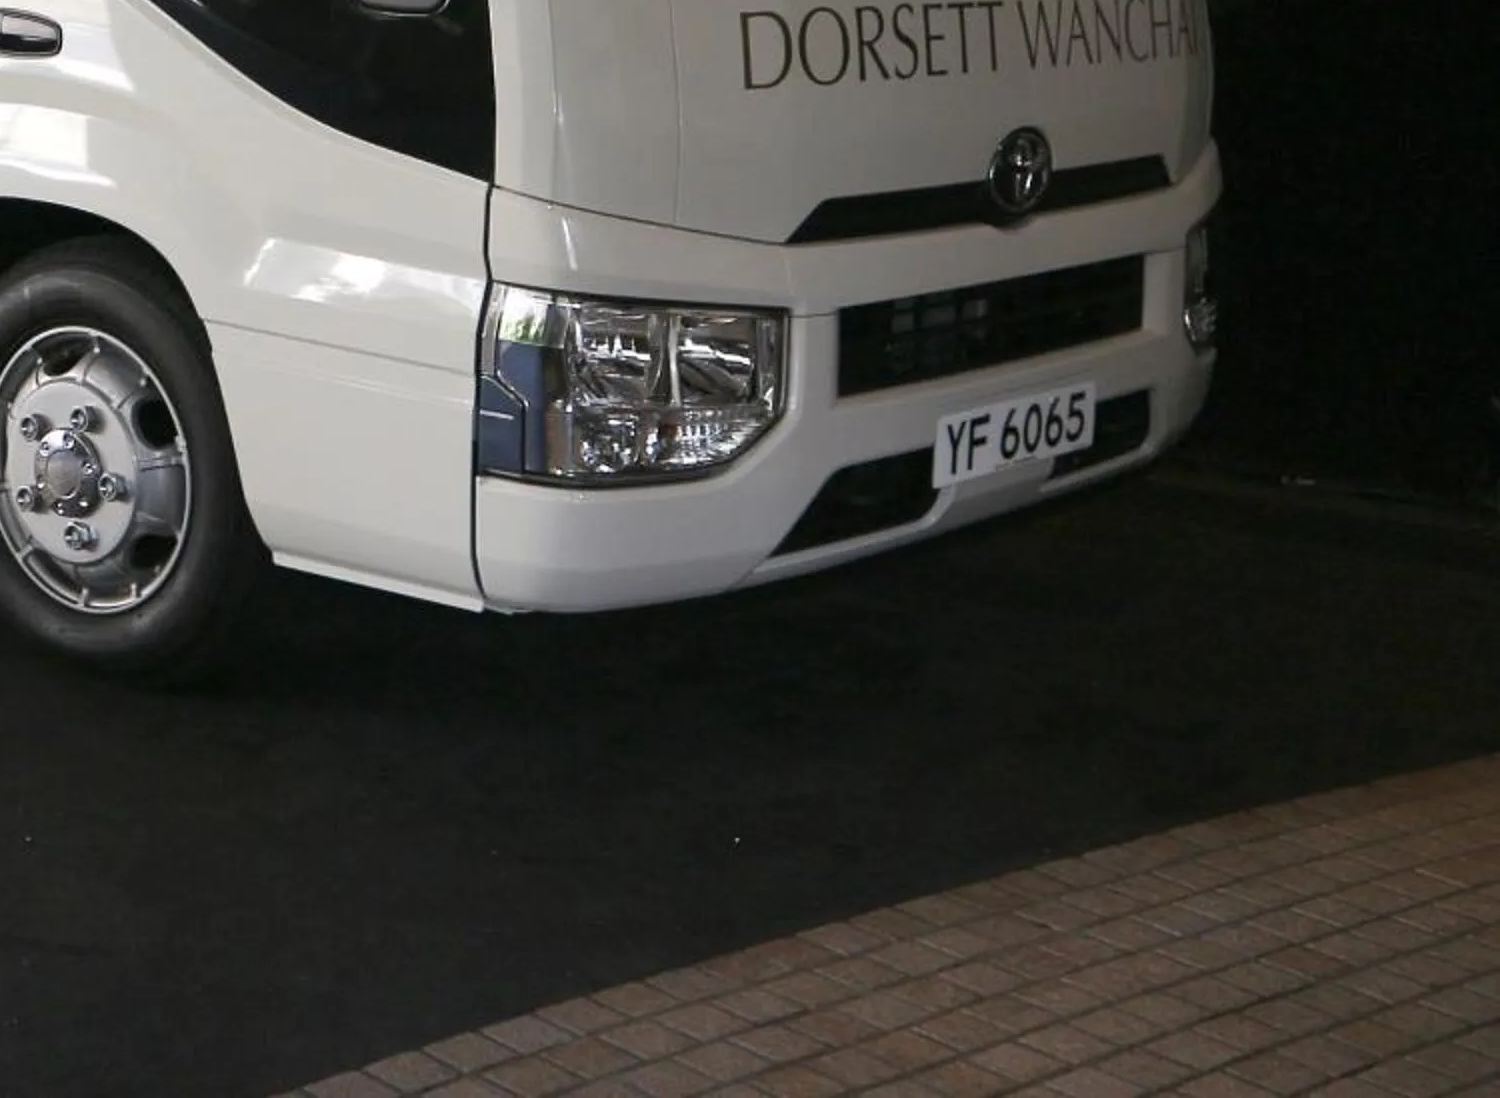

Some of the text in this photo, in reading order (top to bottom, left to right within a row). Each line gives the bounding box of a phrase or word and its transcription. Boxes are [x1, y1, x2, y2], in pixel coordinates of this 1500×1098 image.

[739, 0, 1004, 90] DORSETT
[947, 390, 1086, 475] YF 6065
